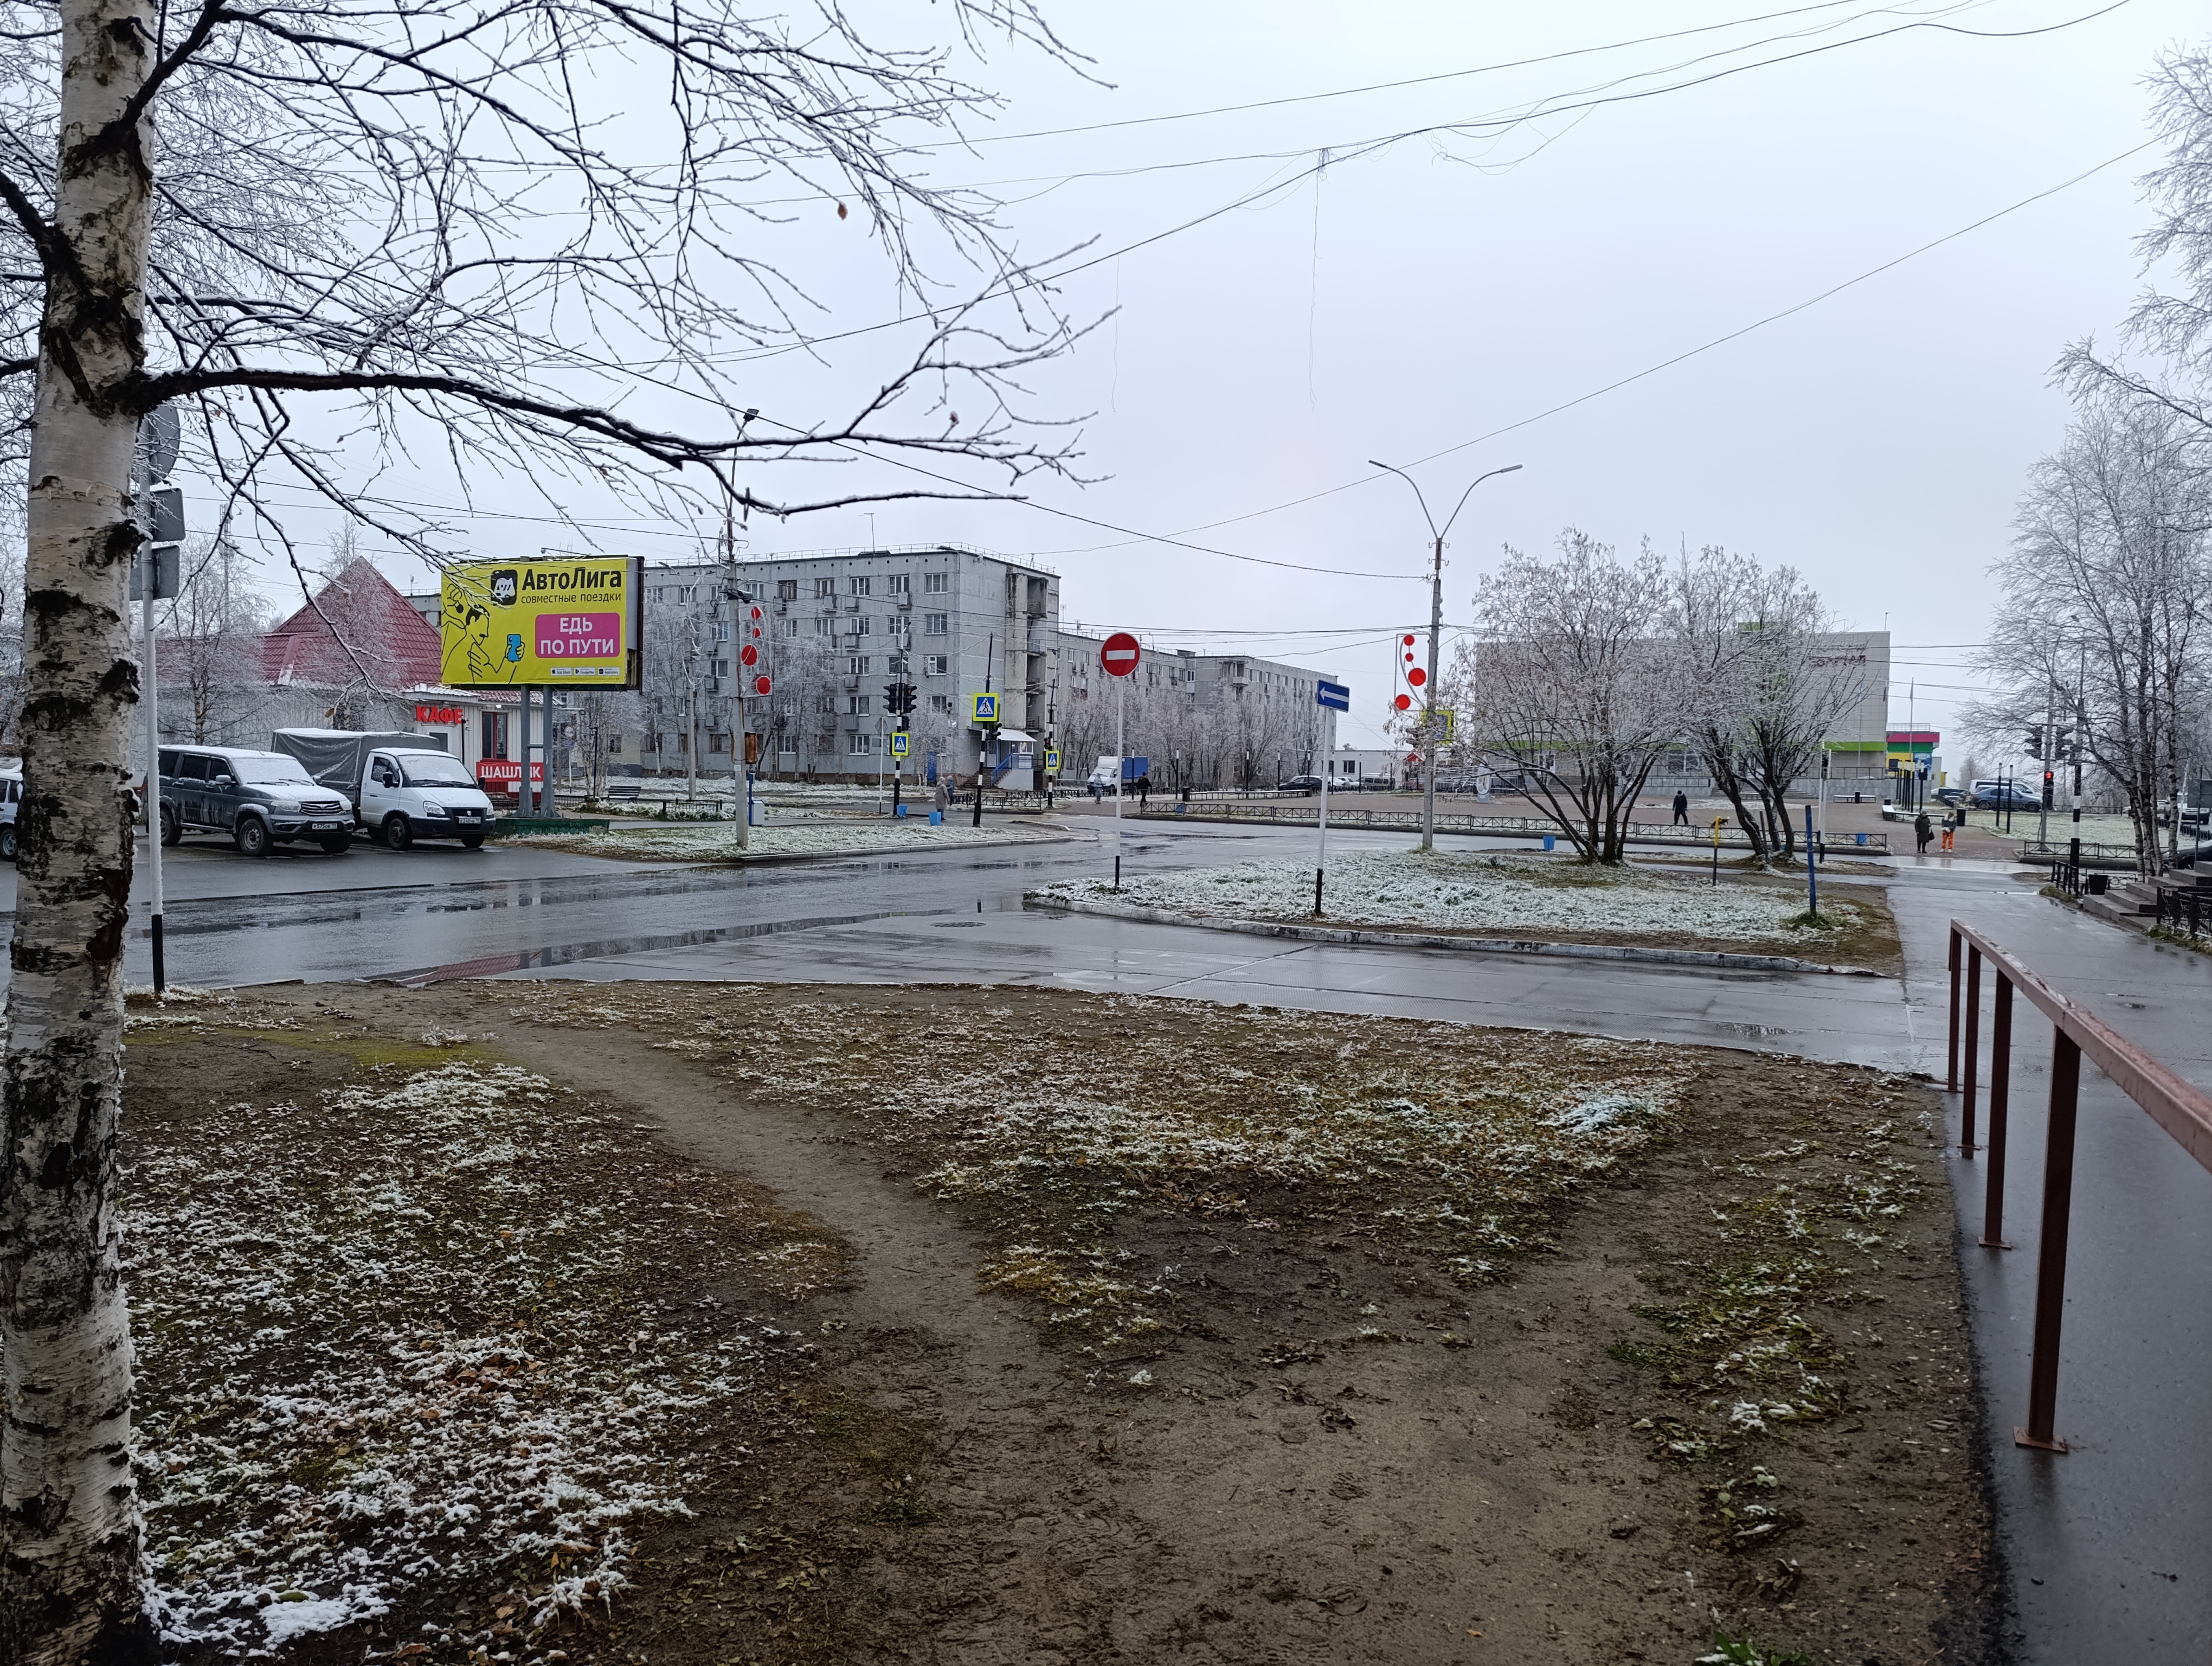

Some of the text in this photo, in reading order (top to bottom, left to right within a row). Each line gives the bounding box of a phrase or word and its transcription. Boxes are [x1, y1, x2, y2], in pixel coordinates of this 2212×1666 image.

[522, 567, 621, 590] АвтоЛига
[521, 593, 621, 604] совместные поездки
[560, 617, 593, 635] ЕДЬ
[541, 639, 614, 655] ПО ПУТИ
[416, 706, 463, 723] КАФЕ
[481, 766, 541, 778] ШАШЛК
